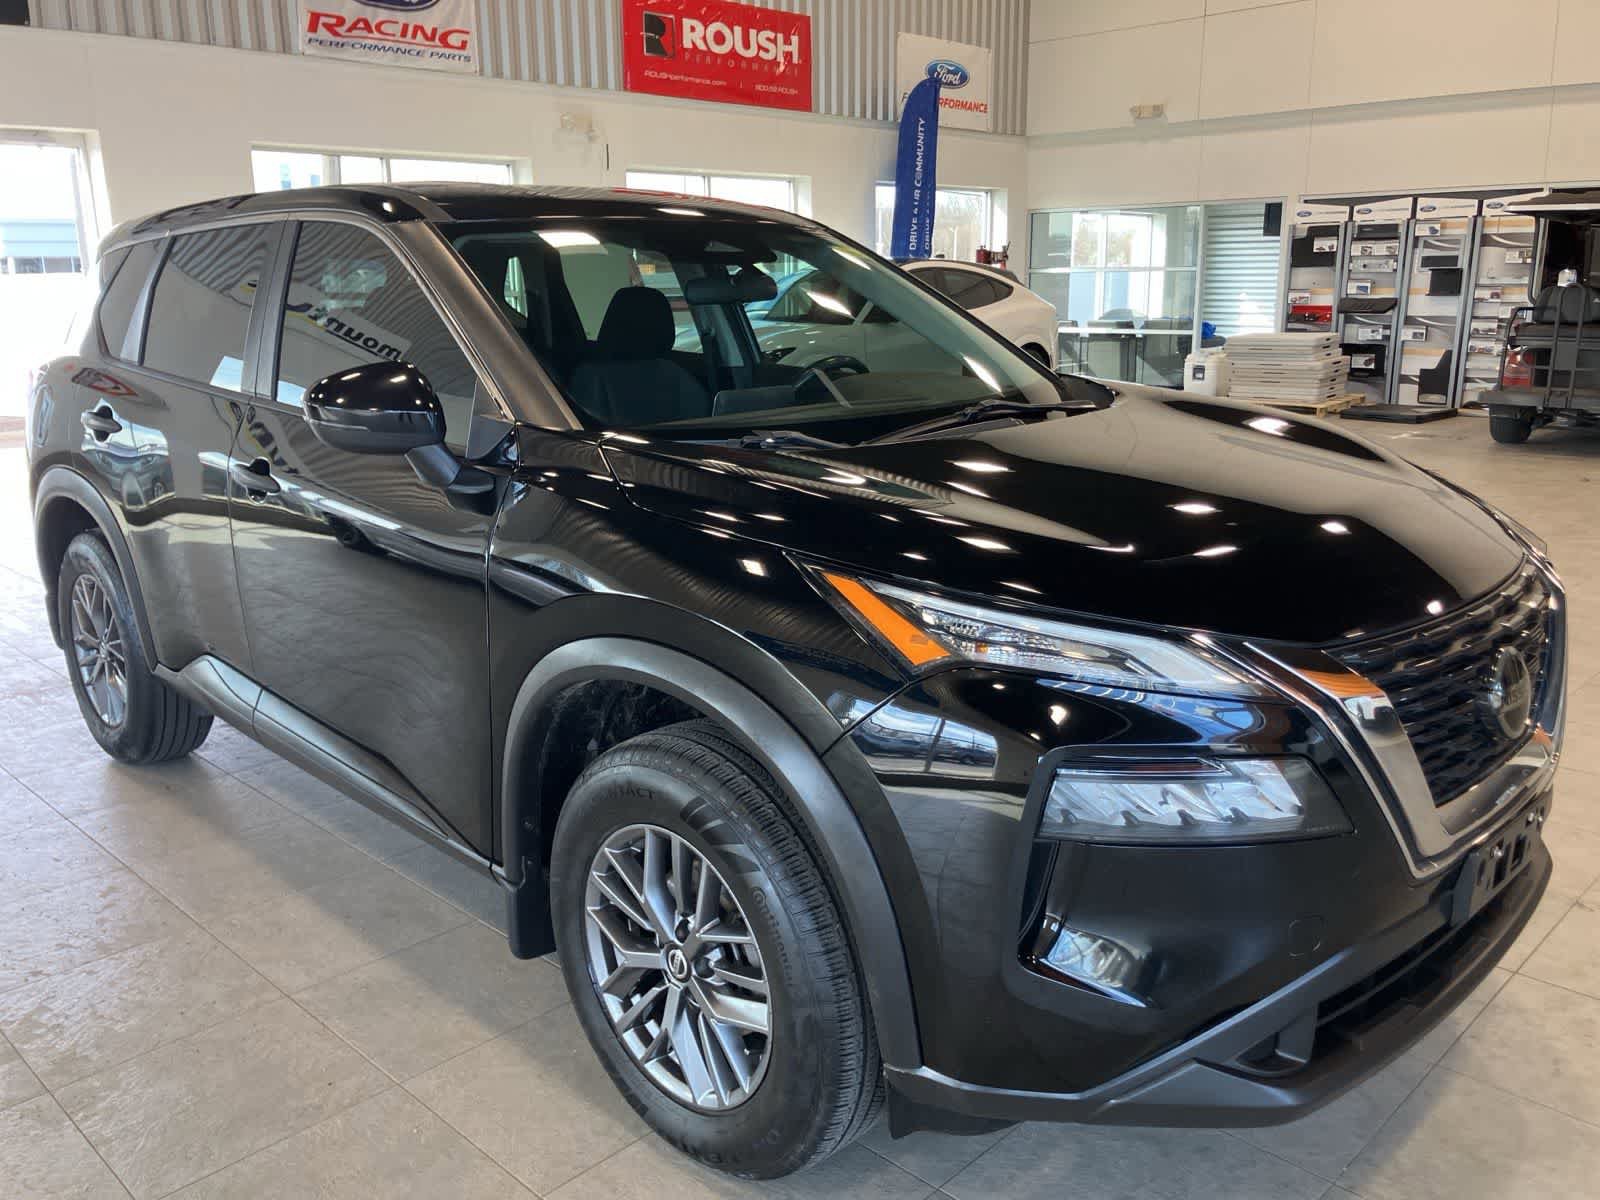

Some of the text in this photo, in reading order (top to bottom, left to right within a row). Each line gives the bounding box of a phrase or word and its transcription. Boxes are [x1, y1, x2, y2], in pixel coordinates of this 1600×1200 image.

[307, 11, 470, 50] RACING
[682, 18, 799, 64] ROUSH
[308, 37, 471, 63] PERFORMANCE PARTS
[934, 63, 961, 84] Ford
[938, 97, 988, 114] RFORMANCE
[909, 217, 918, 250] DRIVE
